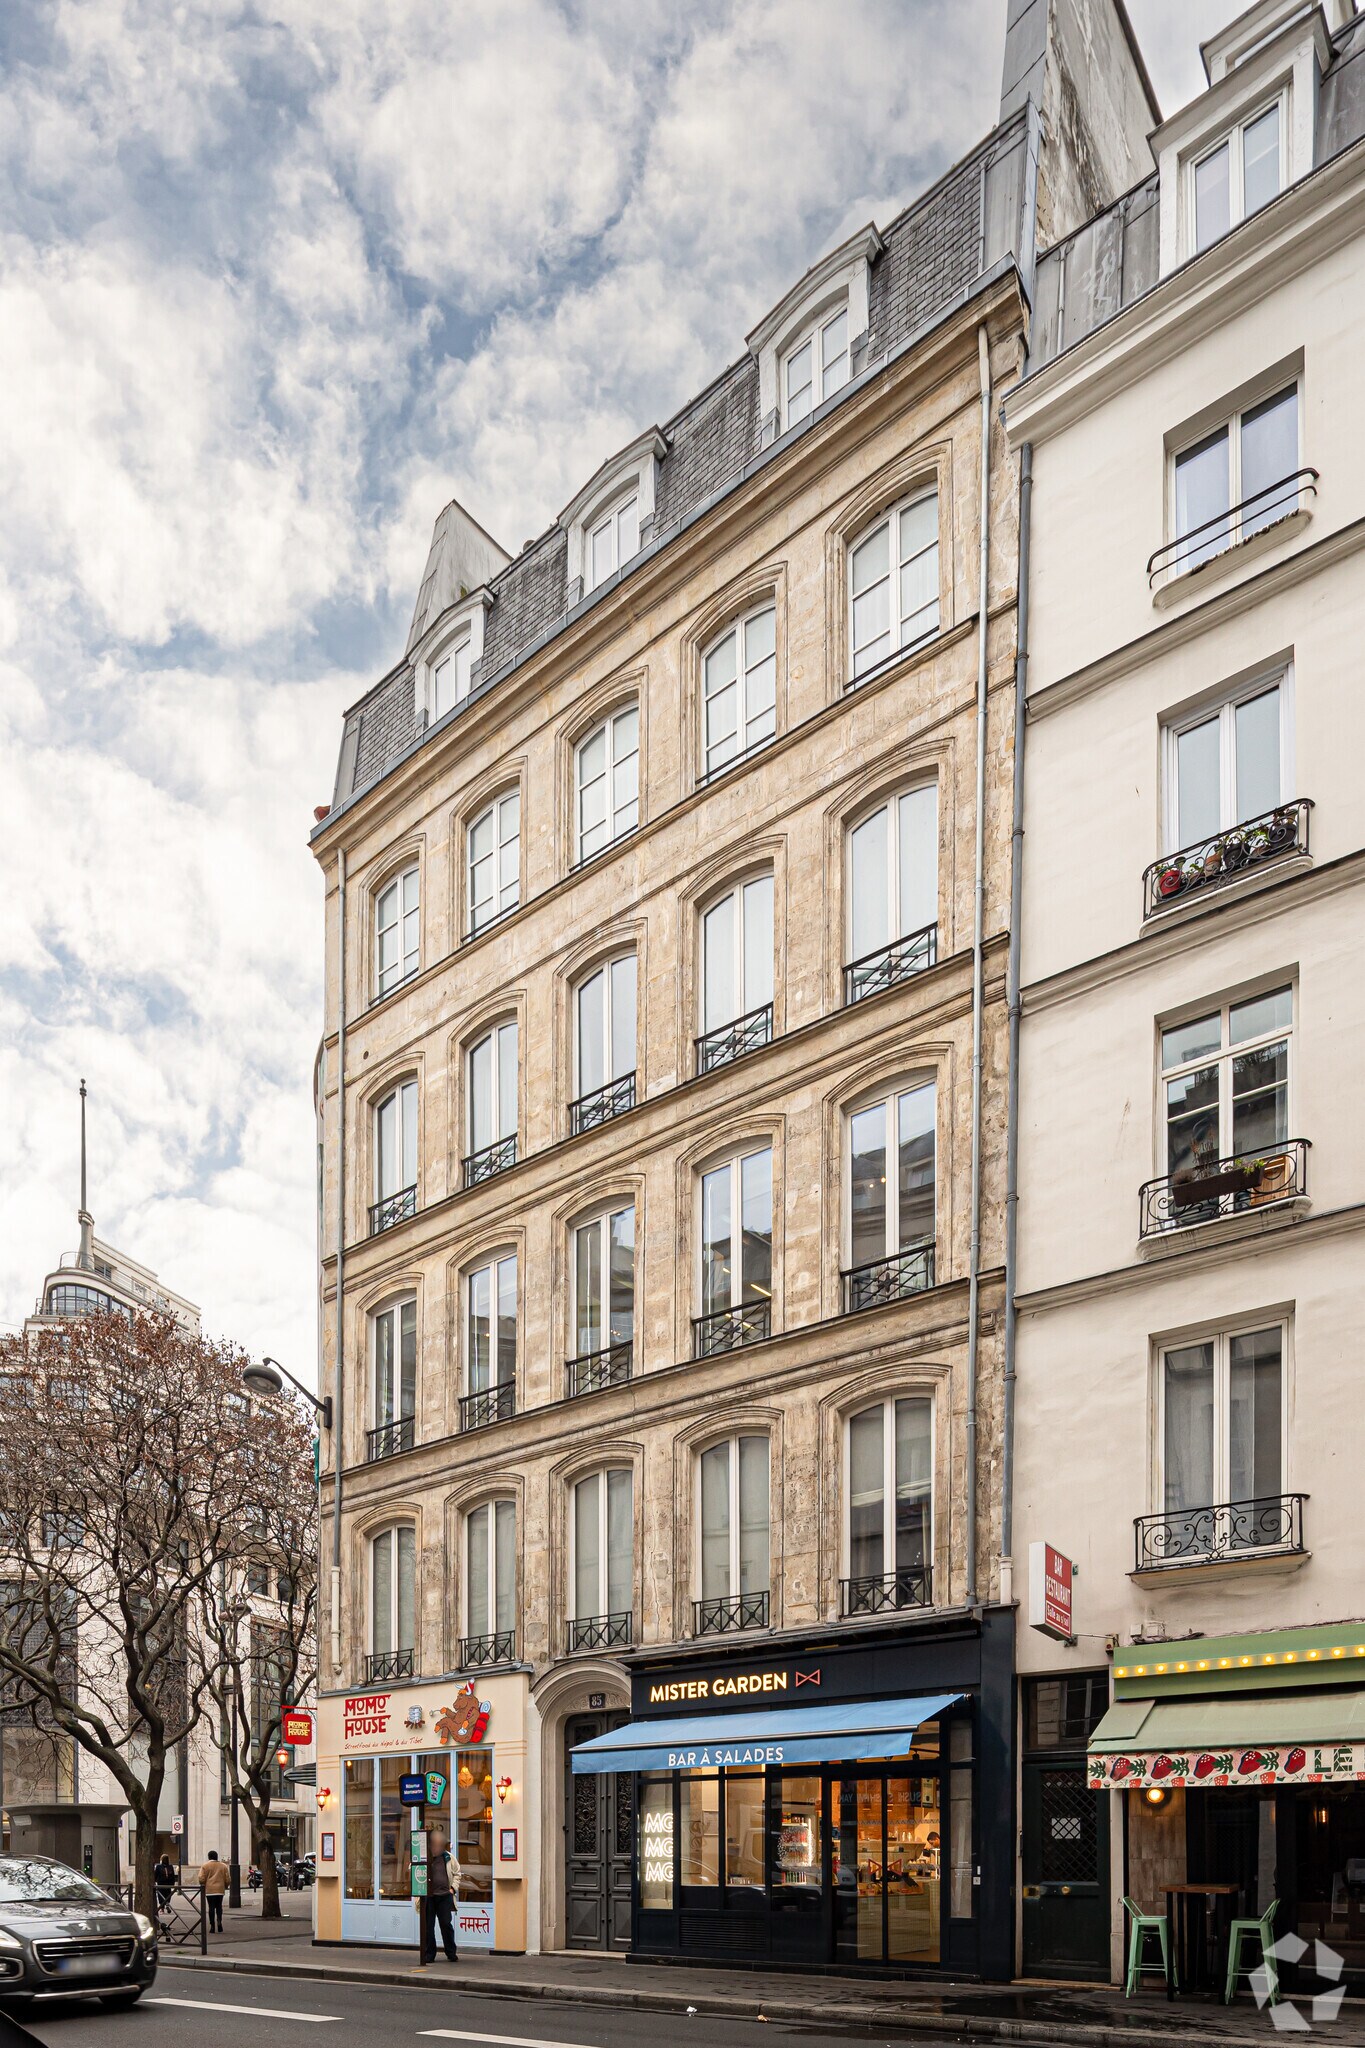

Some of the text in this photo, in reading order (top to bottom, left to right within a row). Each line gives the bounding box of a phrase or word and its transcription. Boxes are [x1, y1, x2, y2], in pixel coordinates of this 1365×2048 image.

[1054, 1554, 1063, 1578] BAR
[1046, 1574, 1071, 1608] RESTAURANT
[650, 1672, 787, 1702] MISTER GARDEN
[343, 1694, 391, 1717] MOMO
[591, 1695, 602, 1706] 85
[345, 1715, 391, 1739] HOUSE
[410, 1736, 423, 1744] Tibet
[668, 1747, 784, 1767] BAR À SALADES
[1314, 1748, 1353, 1773] LE
[644, 1812, 674, 1834] MG
[644, 1836, 674, 1858] MG
[645, 1861, 674, 1883] MG
[459, 1909, 490, 1934] नमस्ते
